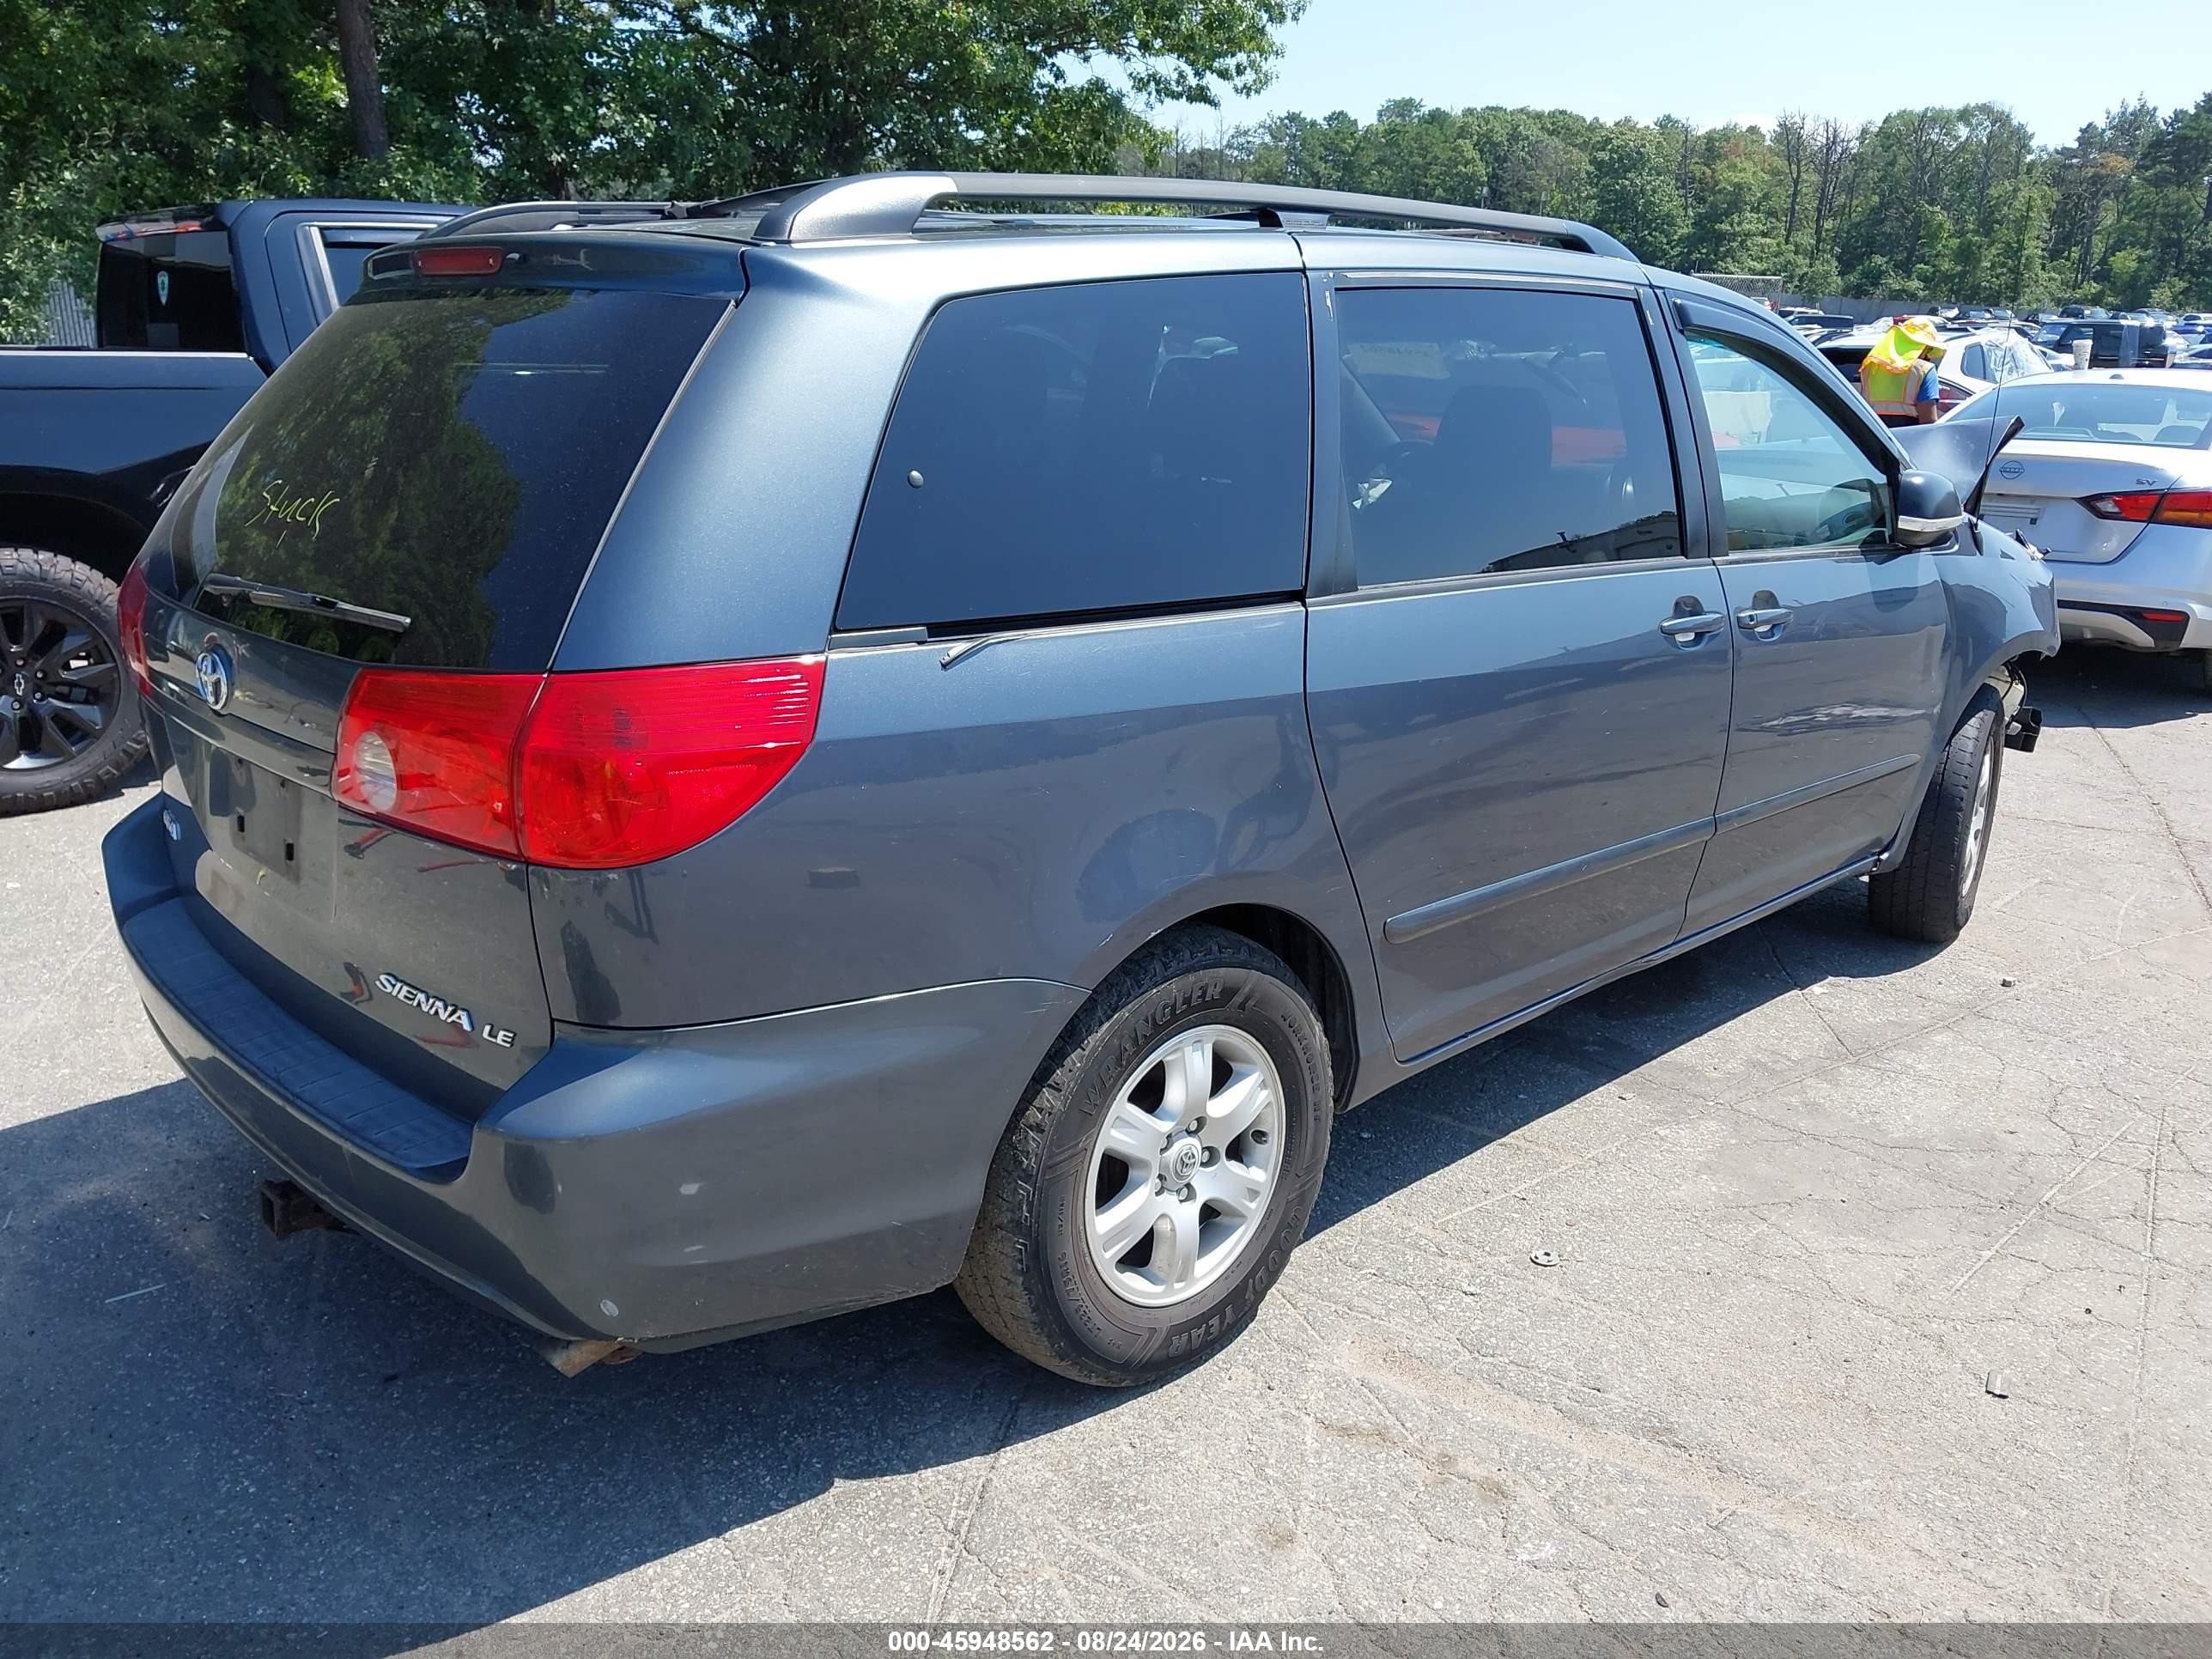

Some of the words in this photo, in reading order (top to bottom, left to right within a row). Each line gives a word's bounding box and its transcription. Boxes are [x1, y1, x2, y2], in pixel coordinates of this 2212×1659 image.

[2136, 477, 2157, 486] SV
[375, 973, 473, 1031] SIENNA
[482, 1024, 514, 1048] LE
[1079, 977, 1224, 1116] WRANGLER
